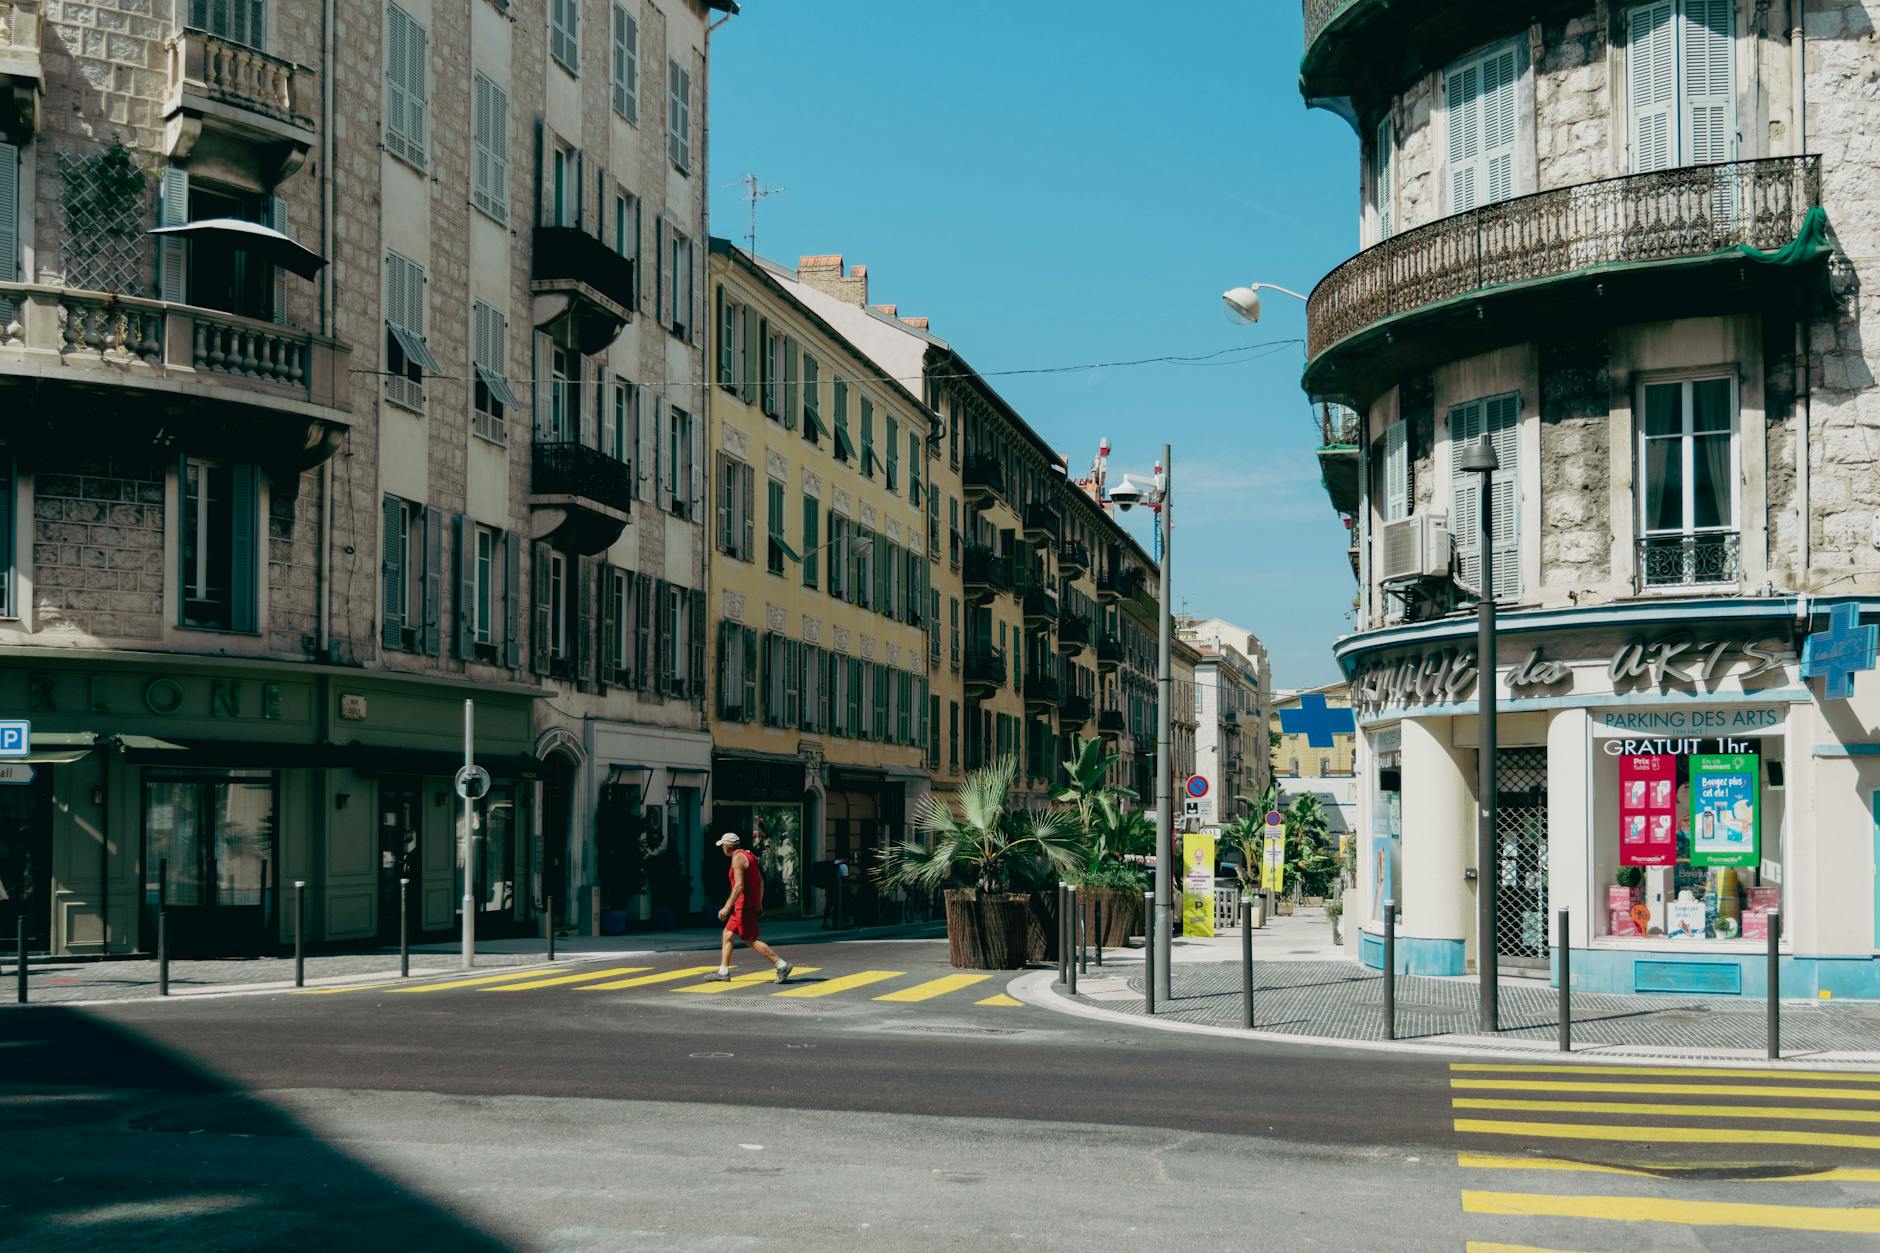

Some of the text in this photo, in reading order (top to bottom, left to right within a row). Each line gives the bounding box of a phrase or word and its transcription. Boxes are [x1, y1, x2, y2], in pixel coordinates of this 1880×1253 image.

[1503, 646, 1569, 688] des
[1608, 632, 1786, 683] ARTS
[1606, 709, 1777, 729] PARKING DES ARTS
[4, 730, 18, 748] P
[1603, 737, 1754, 756] GRATUIT 1hr.
[1702, 777, 1743, 788] Bougez plus
[1703, 788, 1713, 797] cet
